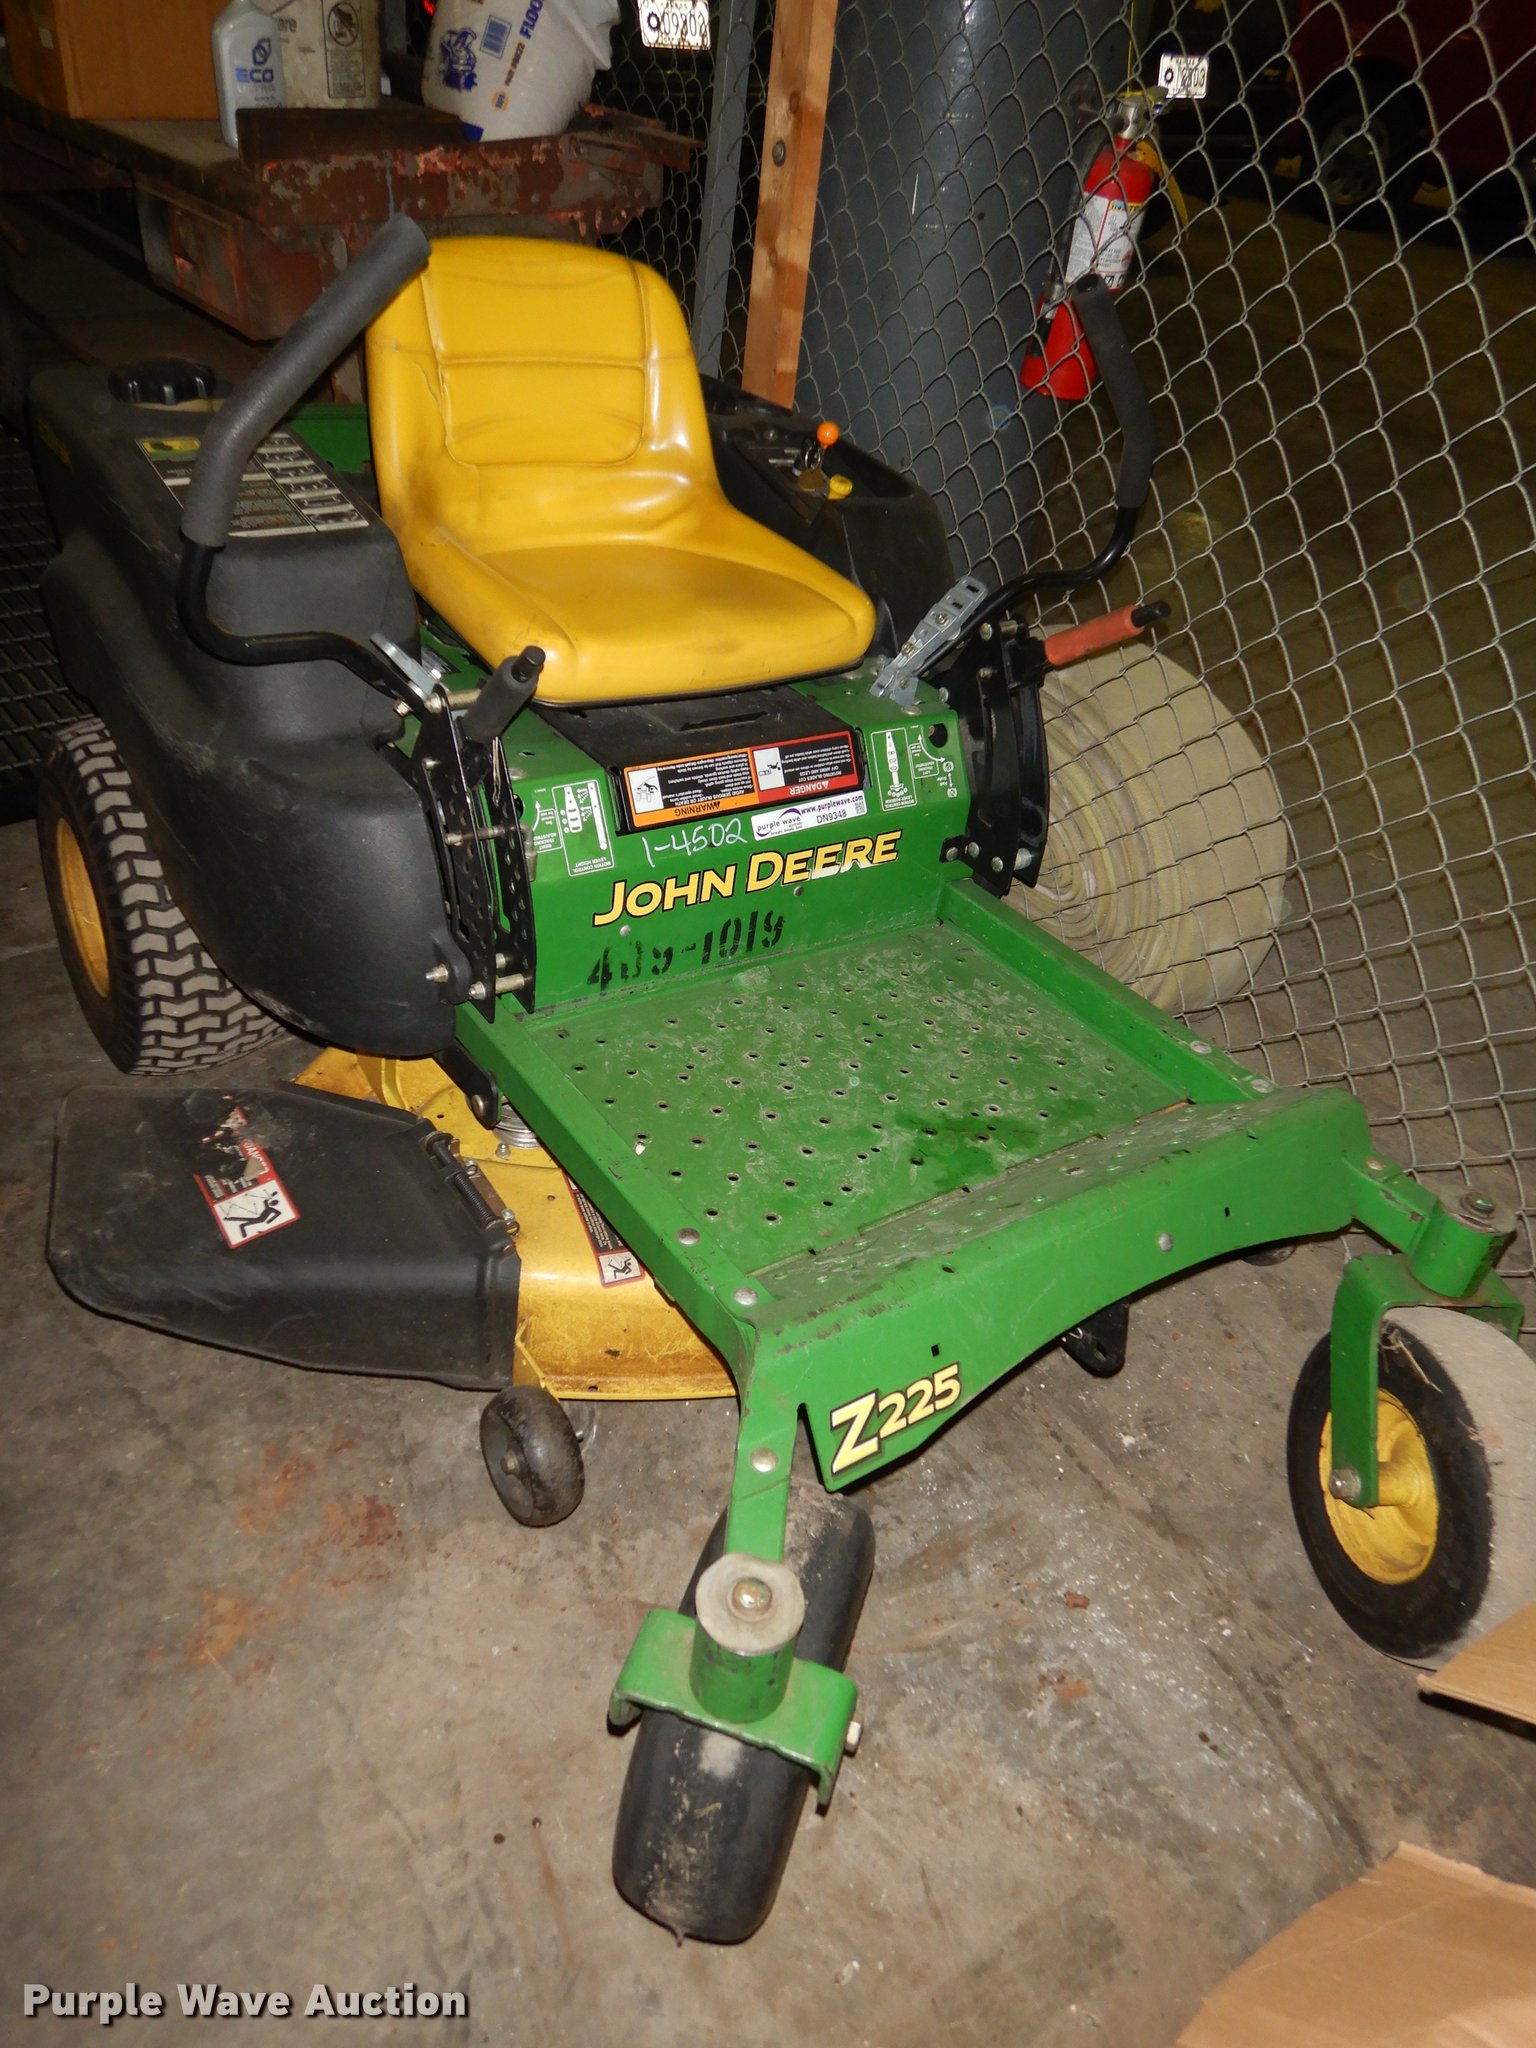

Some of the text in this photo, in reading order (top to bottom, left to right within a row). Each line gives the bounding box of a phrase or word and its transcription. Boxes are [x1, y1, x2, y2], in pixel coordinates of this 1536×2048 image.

[236, 67, 274, 83] ECO
[789, 782, 822, 795] DANGER
[674, 802, 714, 816] WARNING
[800, 794, 863, 814] www.purplewave.com
[756, 815, 800, 831] purple wave
[816, 809, 847, 823] DN9348
[642, 818, 748, 868] 1-4502
[593, 829, 903, 926] JOHN DEERE
[830, 1361, 961, 1475] Z225
